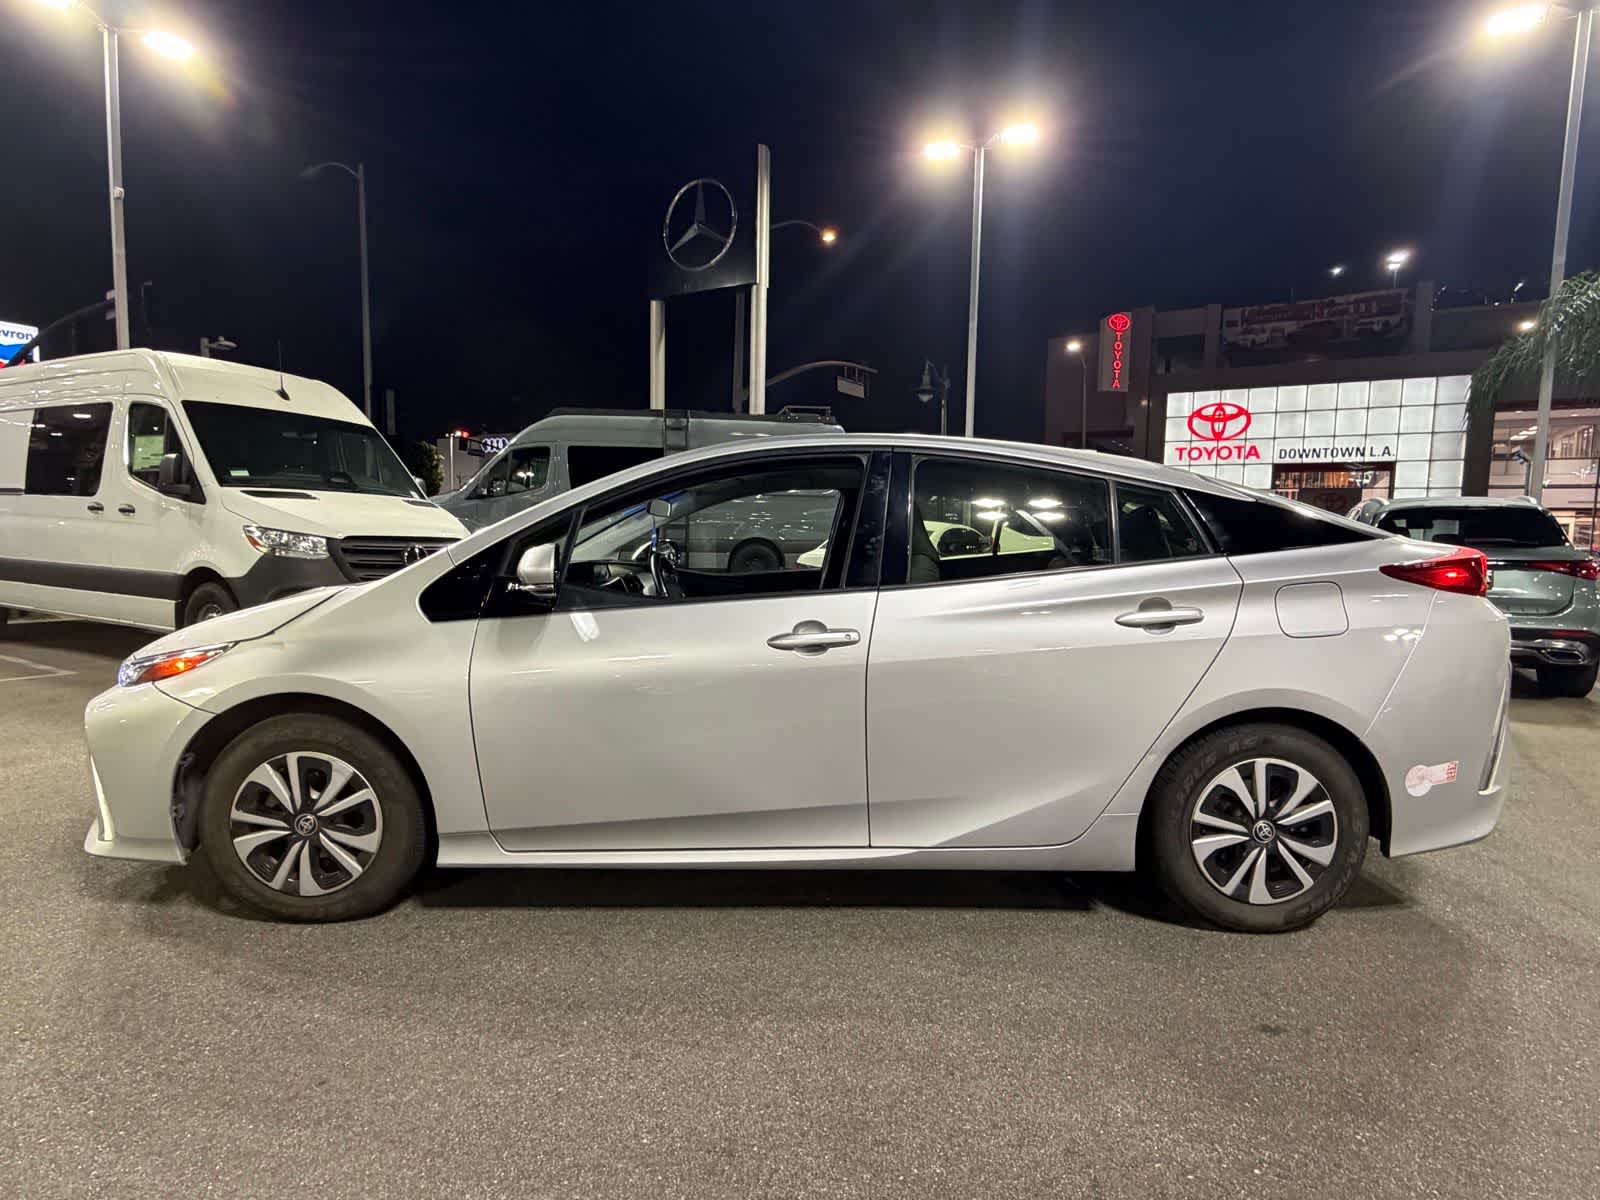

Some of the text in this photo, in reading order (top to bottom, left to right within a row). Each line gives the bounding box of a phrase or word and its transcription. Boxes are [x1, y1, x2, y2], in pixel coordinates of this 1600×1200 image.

[1112, 331, 1123, 390] TOYOTA
[1175, 445, 1261, 461] TOYOTA
[1278, 445, 1396, 460] DOWNTOWN L.A.
